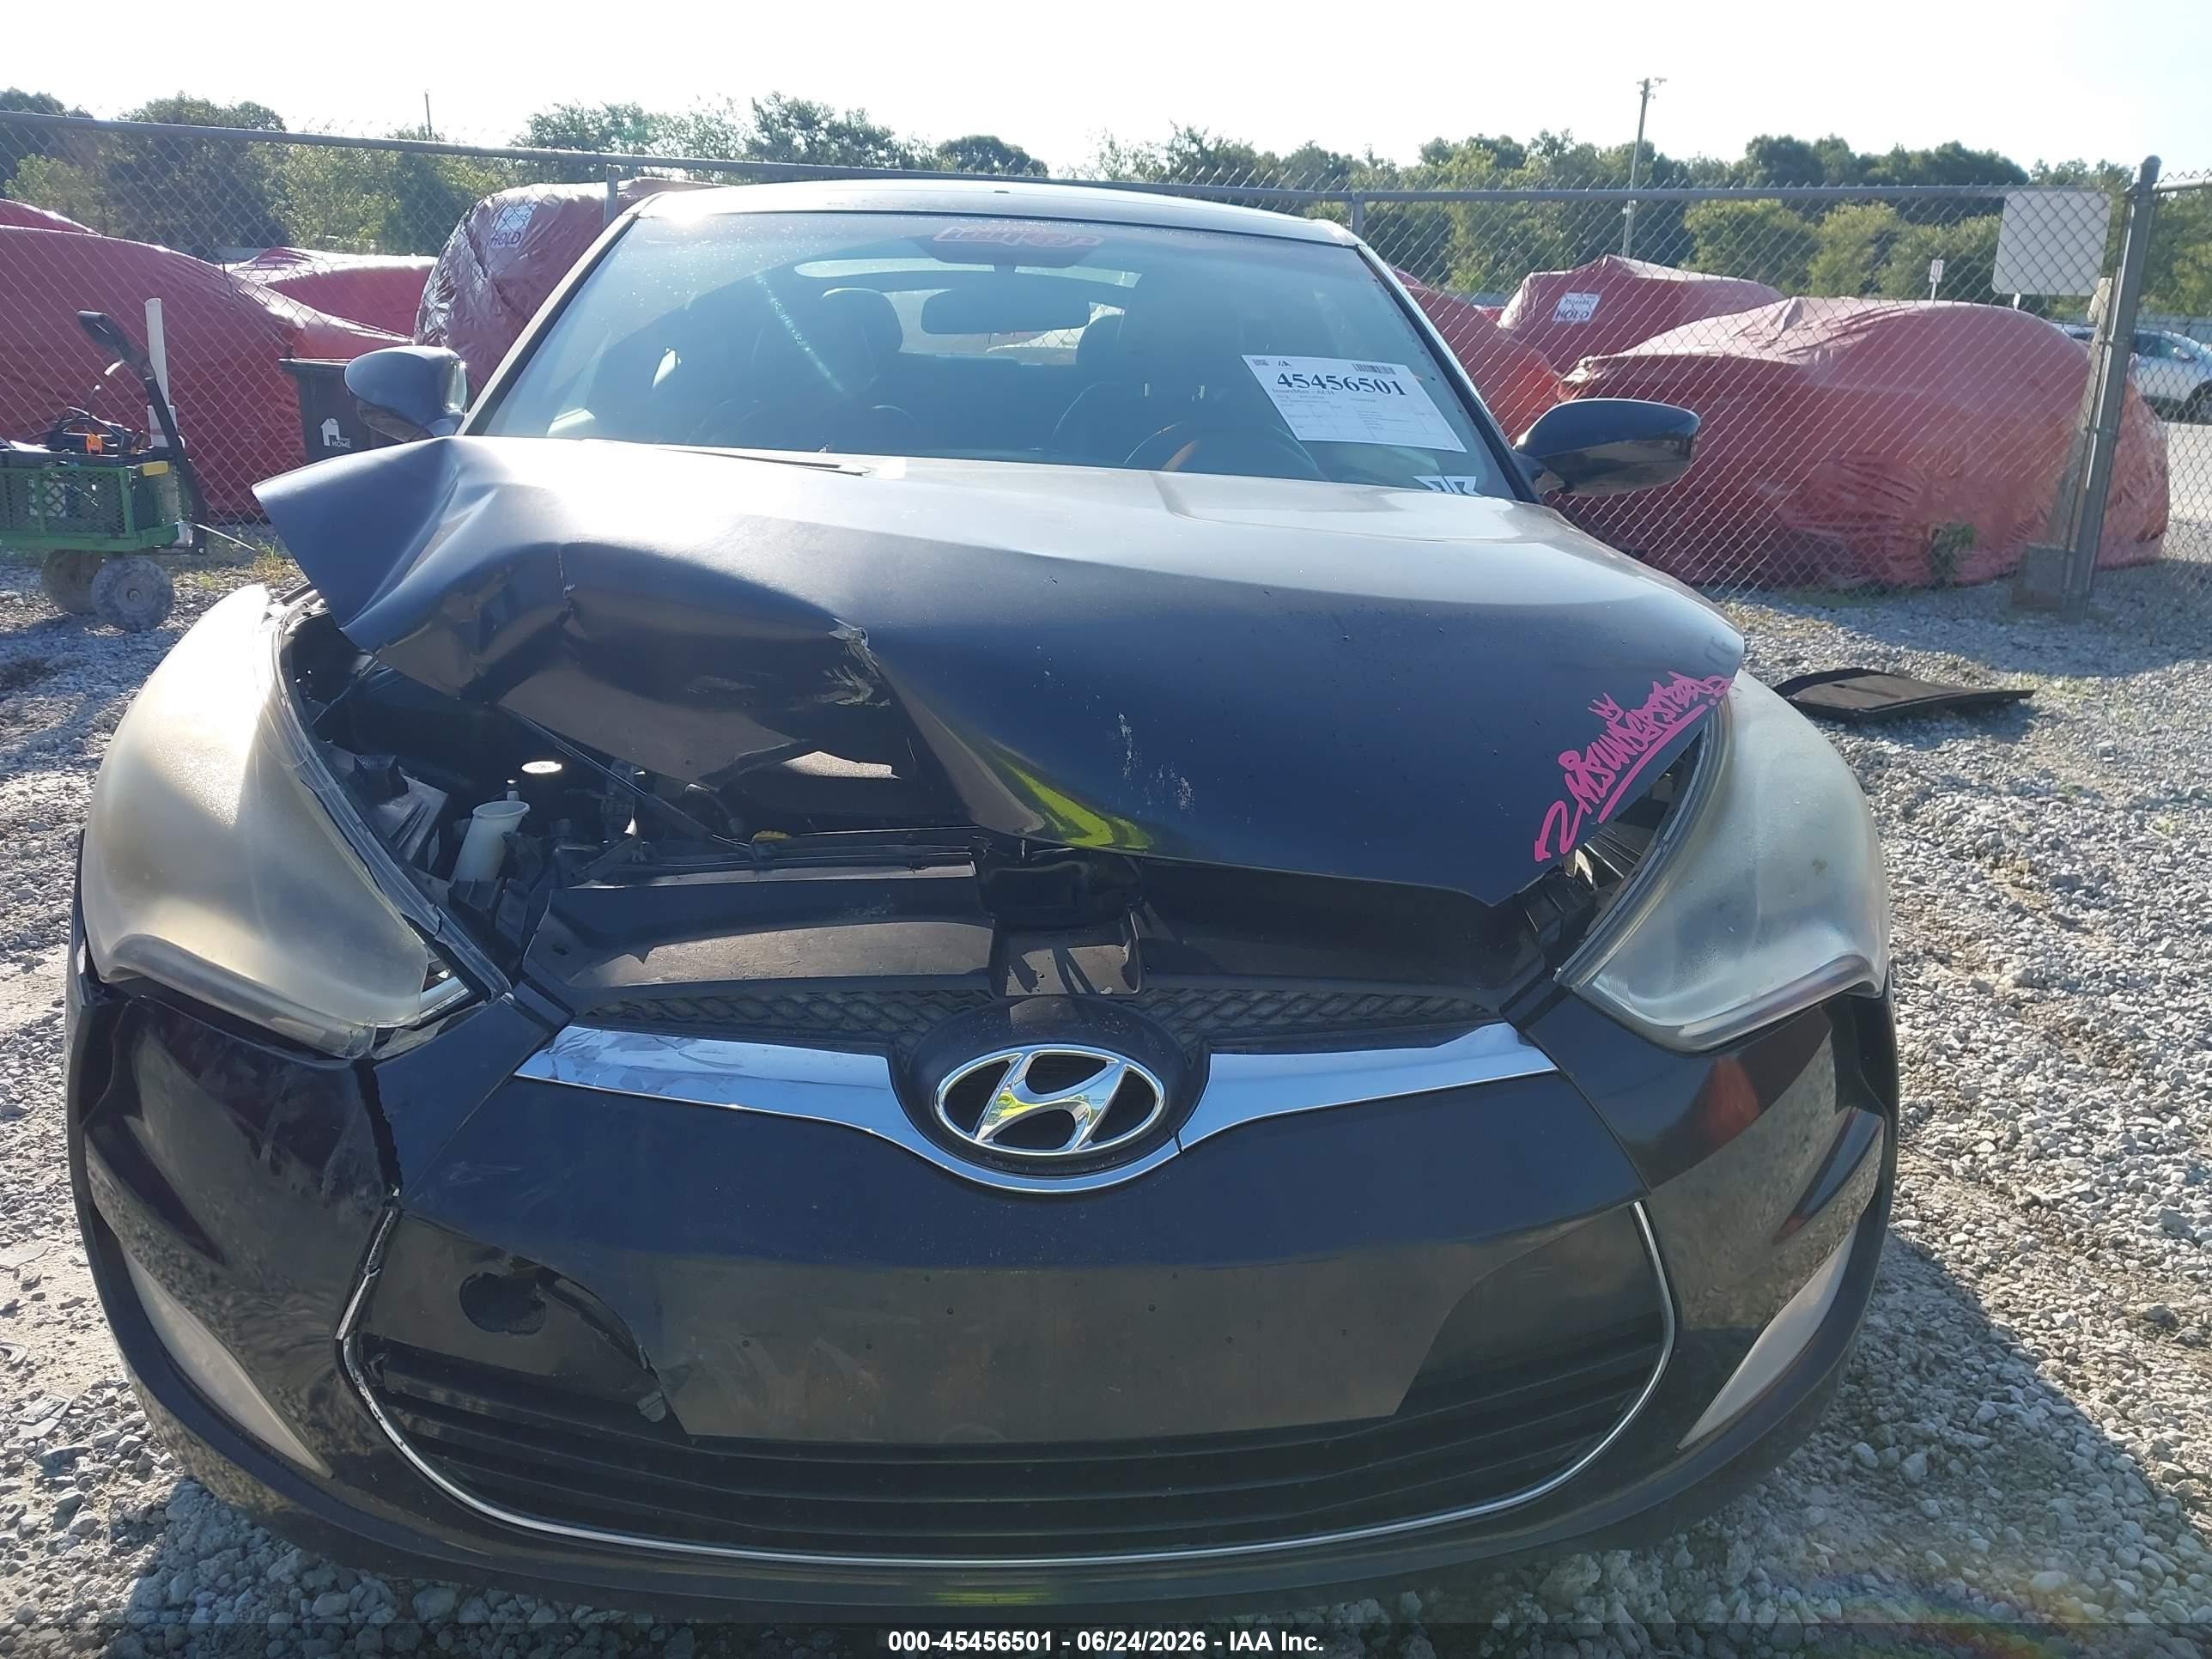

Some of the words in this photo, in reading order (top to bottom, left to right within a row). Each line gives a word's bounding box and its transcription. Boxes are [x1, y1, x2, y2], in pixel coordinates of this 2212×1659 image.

[489, 231, 521, 246] HOLD
[1555, 310, 1589, 319] HOLD
[1277, 372, 1407, 396] 45456501
